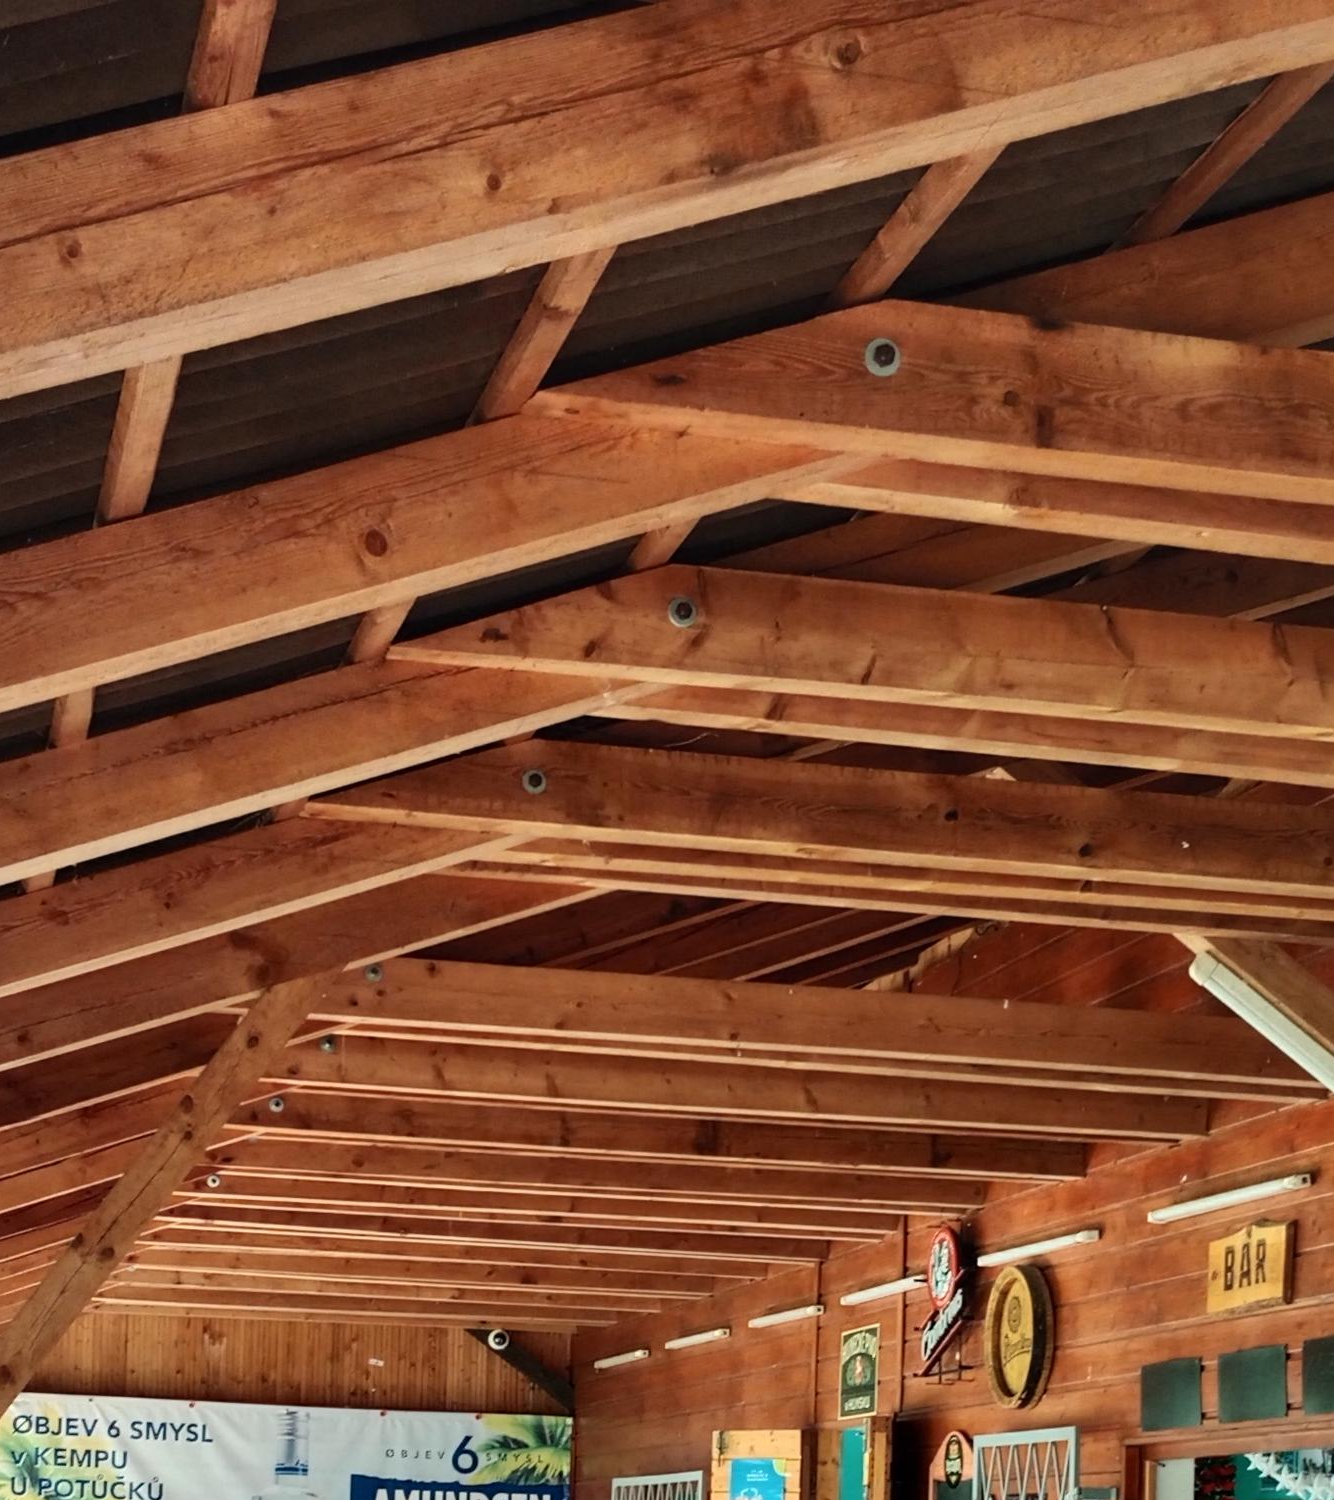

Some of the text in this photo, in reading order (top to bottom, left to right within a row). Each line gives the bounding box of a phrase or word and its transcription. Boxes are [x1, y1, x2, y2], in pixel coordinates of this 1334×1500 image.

[1223, 1239, 1267, 1292] BAR
[107, 1420, 121, 1438] 6
[130, 1421, 214, 1443] SMYSL
[34, 1447, 128, 1469] KEMPU
[452, 1435, 479, 1474] 6
[486, 1452, 544, 1463] SMYSL
[11, 1474, 164, 1500] U POTŮČKŮ
